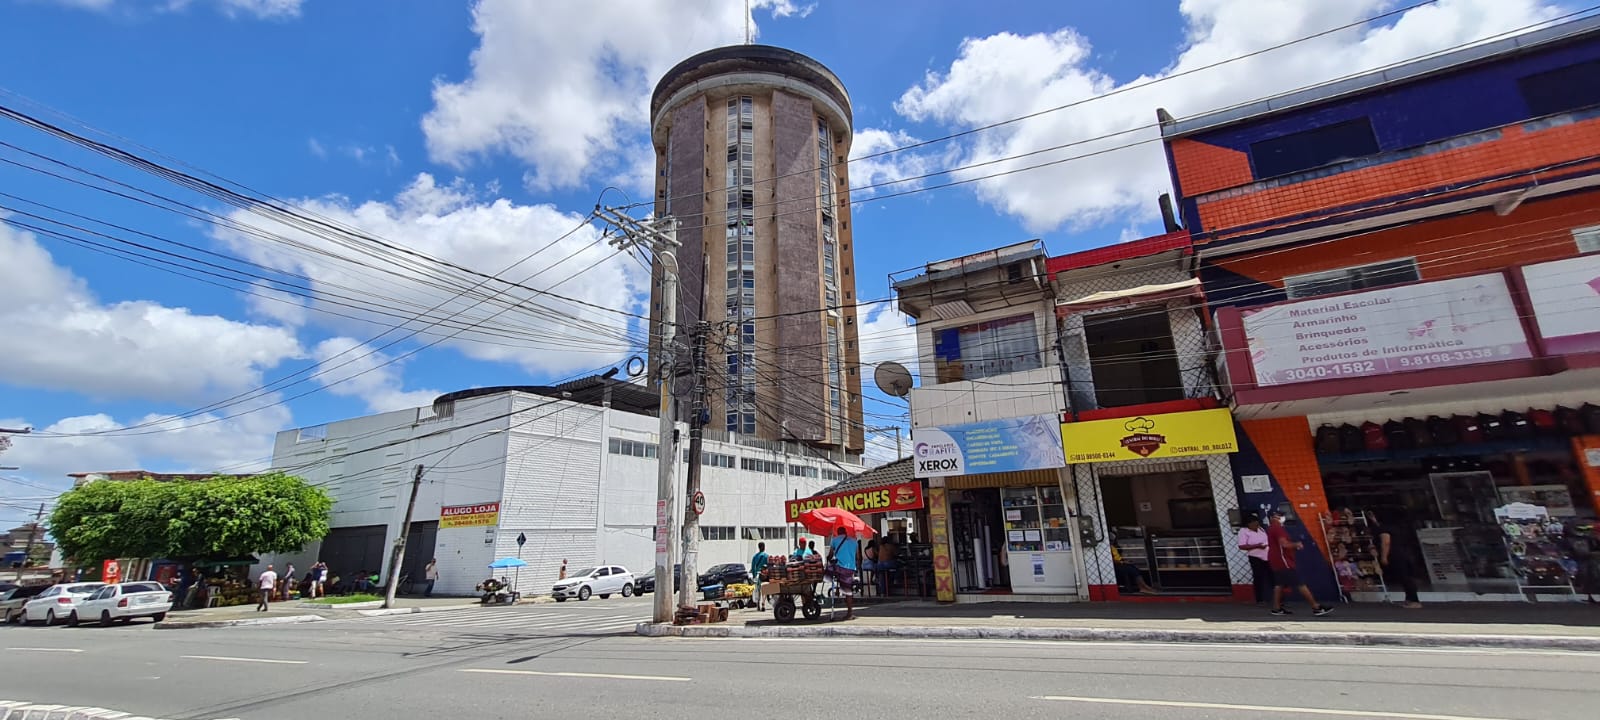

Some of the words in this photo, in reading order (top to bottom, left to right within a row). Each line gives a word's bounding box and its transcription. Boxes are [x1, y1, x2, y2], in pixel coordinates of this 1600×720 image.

[1289, 303, 1340, 317] Material
[1343, 297, 1392, 310] Escolar
[1293, 313, 1358, 329] Armarinho
[1295, 325, 1367, 341] Brinquedos
[1299, 337, 1369, 352] Acessórios
[1302, 351, 1359, 364] Produtos
[1362, 348, 1378, 358] de
[1382, 339, 1464, 355] Informática
[1285, 360, 1376, 381] 3040-1582
[1400, 348, 1493, 367] 9.8198-3338
[919, 458, 958, 472] XEROX
[696, 495, 703, 506] 40
[828, 489, 890, 512] LANCHES
[443, 507, 472, 516] ALUGO
[474, 504, 497, 513] LOJA
[929, 492, 952, 593] XOX
